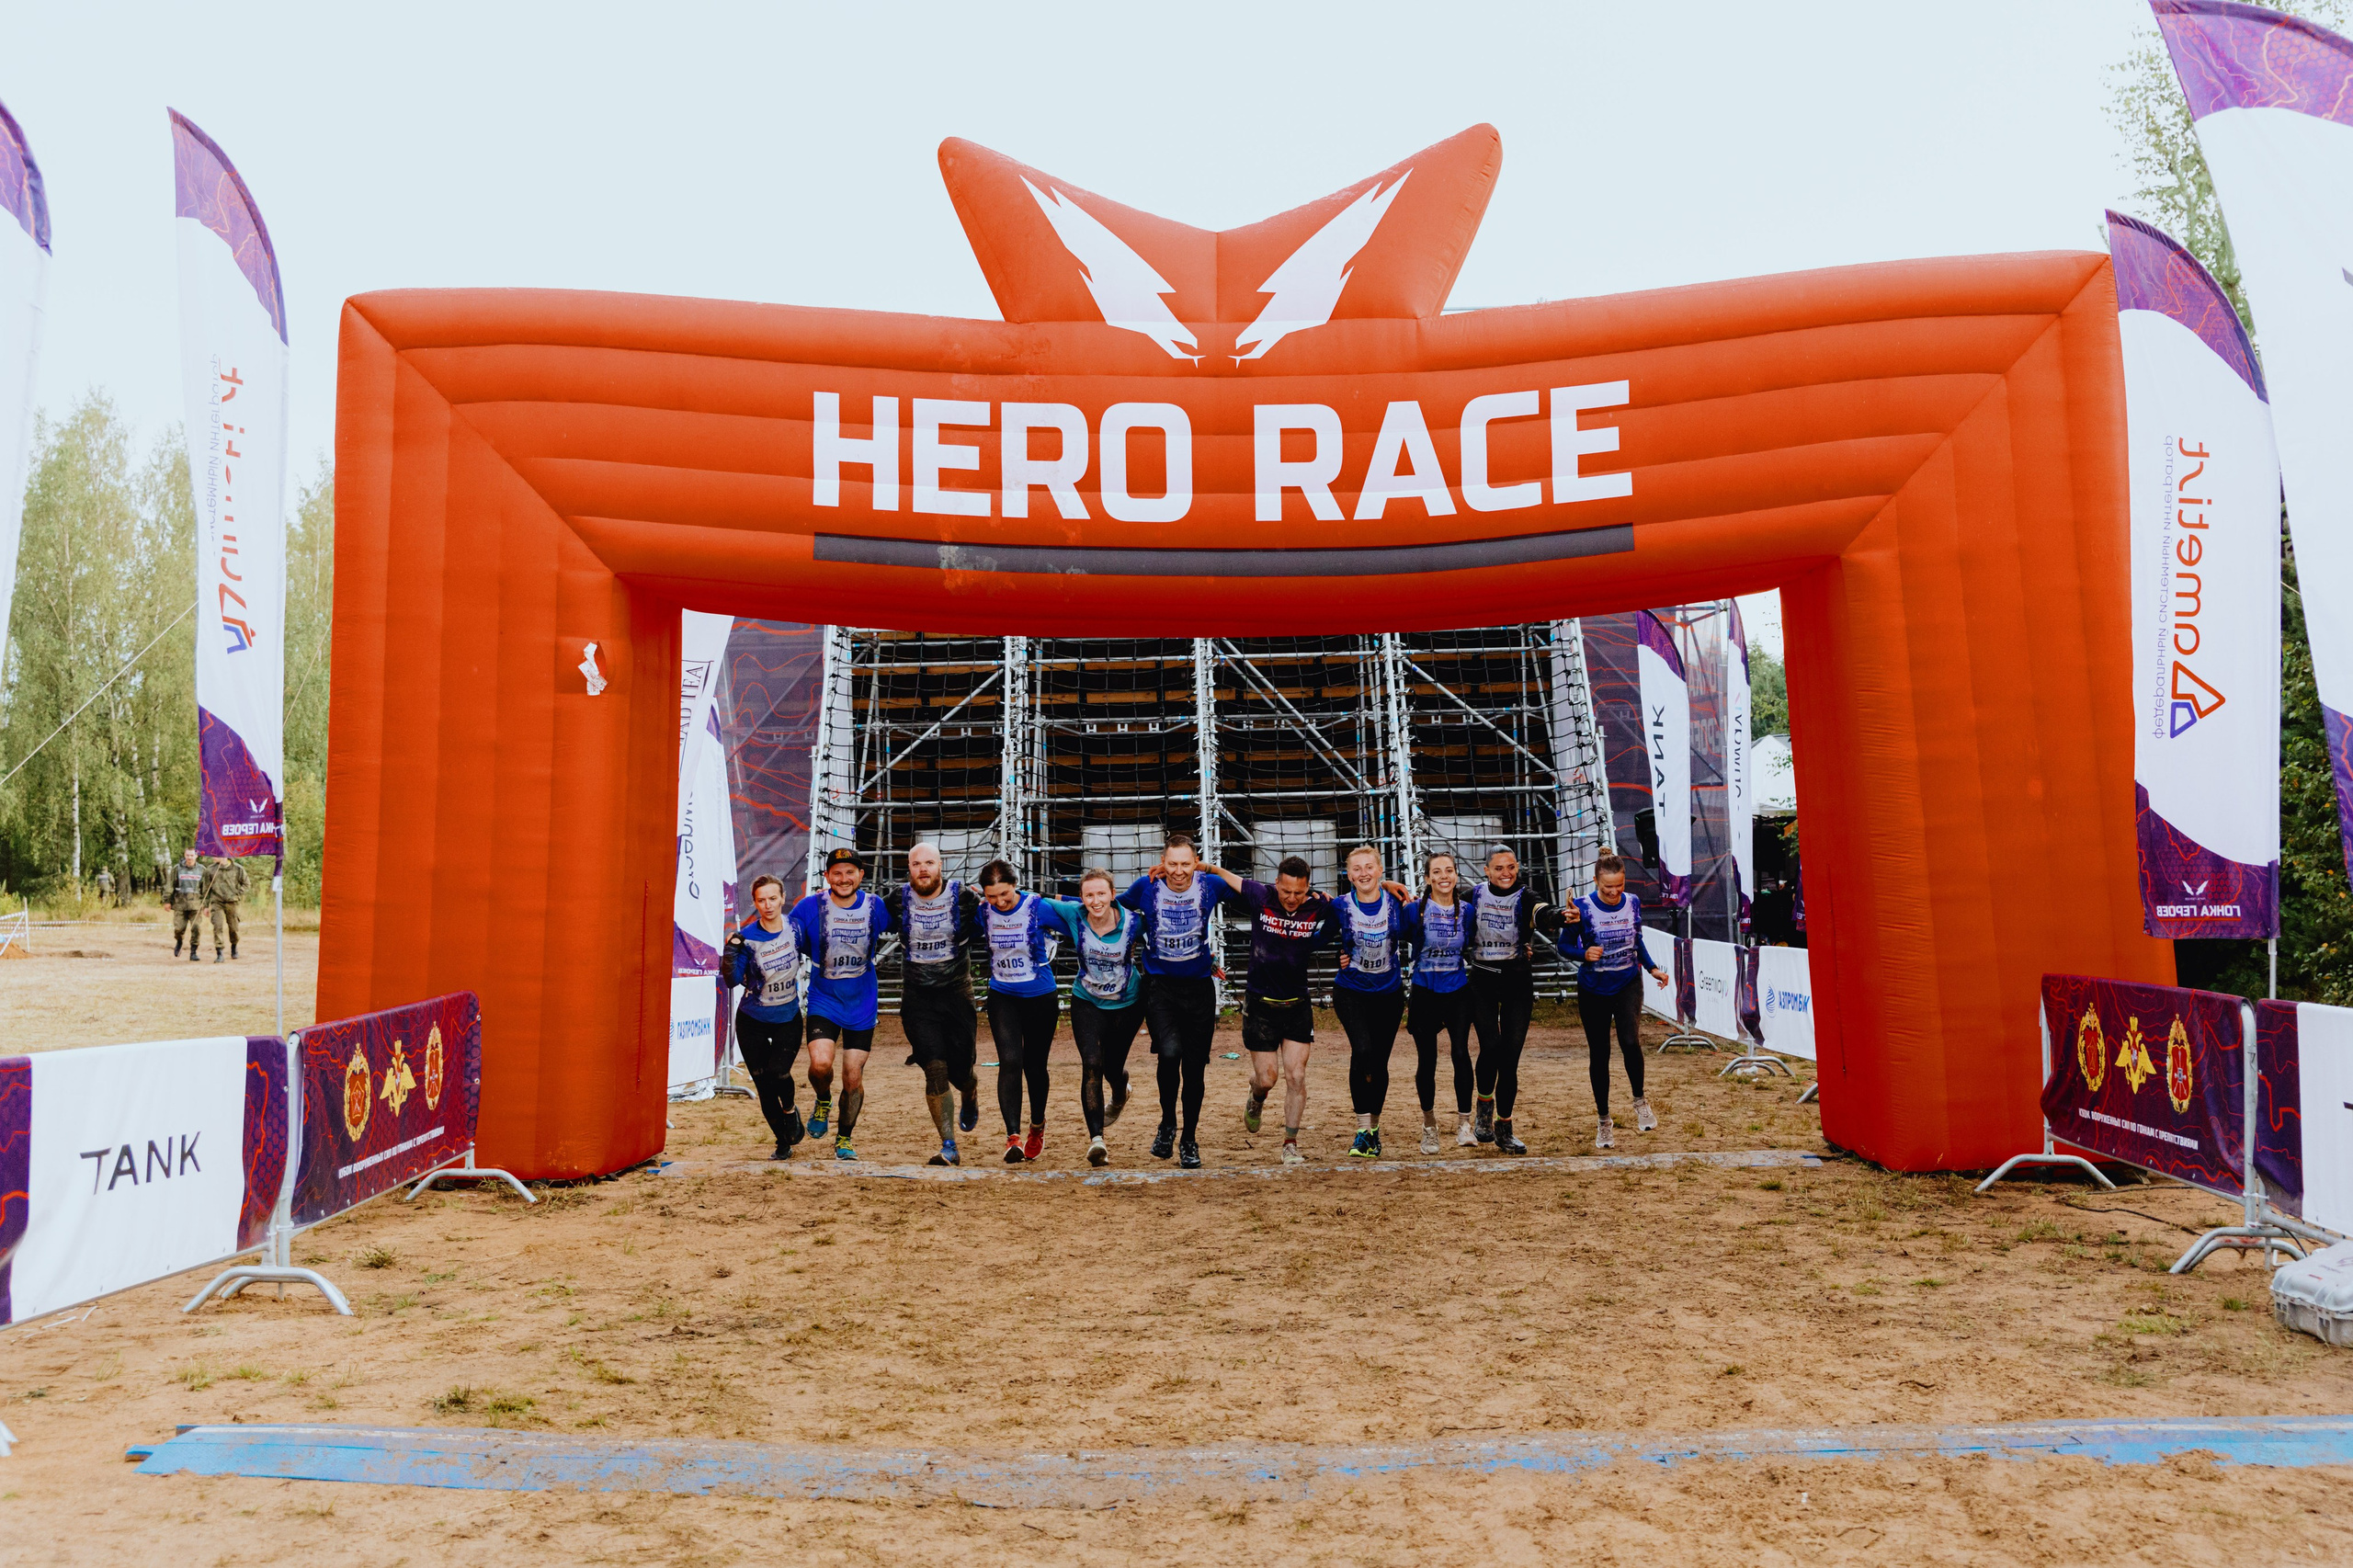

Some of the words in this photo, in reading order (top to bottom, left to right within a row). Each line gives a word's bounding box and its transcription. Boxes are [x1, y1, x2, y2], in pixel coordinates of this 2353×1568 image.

[813, 391, 1193, 522] HERO
[1254, 380, 1634, 521] RACE
[1259, 913, 1316, 930] ИНСТРУКТОР
[1263, 925, 1287, 936] ГОНКА
[917, 939, 946, 950] 18109
[1164, 937, 1193, 949] 18110
[834, 956, 862, 967] 18102
[997, 958, 1024, 969] 18105
[1359, 956, 1386, 969] 18101
[80, 1131, 201, 1195] TANK
